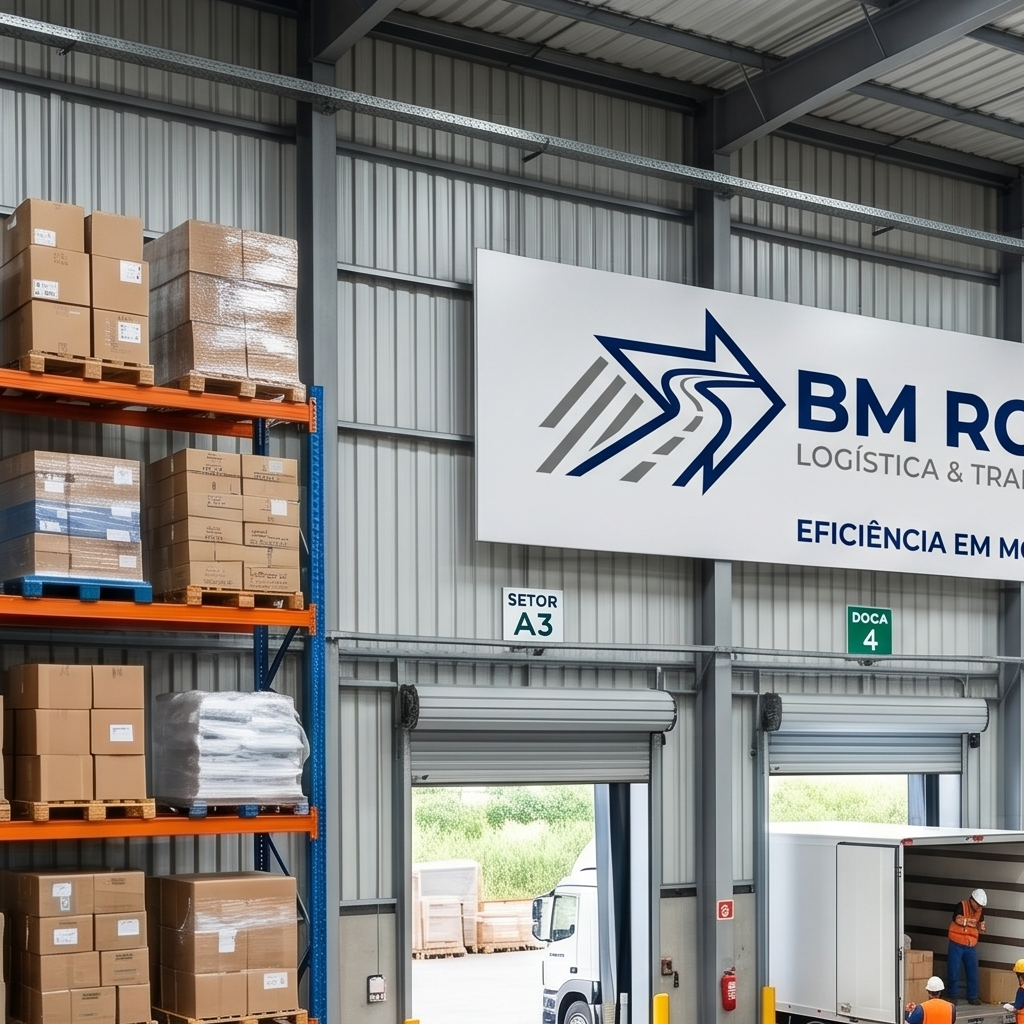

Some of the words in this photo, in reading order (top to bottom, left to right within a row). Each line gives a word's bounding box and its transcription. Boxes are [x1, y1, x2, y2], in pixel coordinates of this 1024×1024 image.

[798, 369, 917, 443] BM
[797, 442, 940, 481] LOGÍSTICA
[946, 460, 964, 483] &
[797, 518, 947, 554] EFICIÊNCIA
[954, 532, 990, 558] EM
[507, 592, 558, 609] SETOR
[513, 611, 553, 637] A3
[852, 611, 888, 625] DOCA
[862, 628, 879, 651] 4
